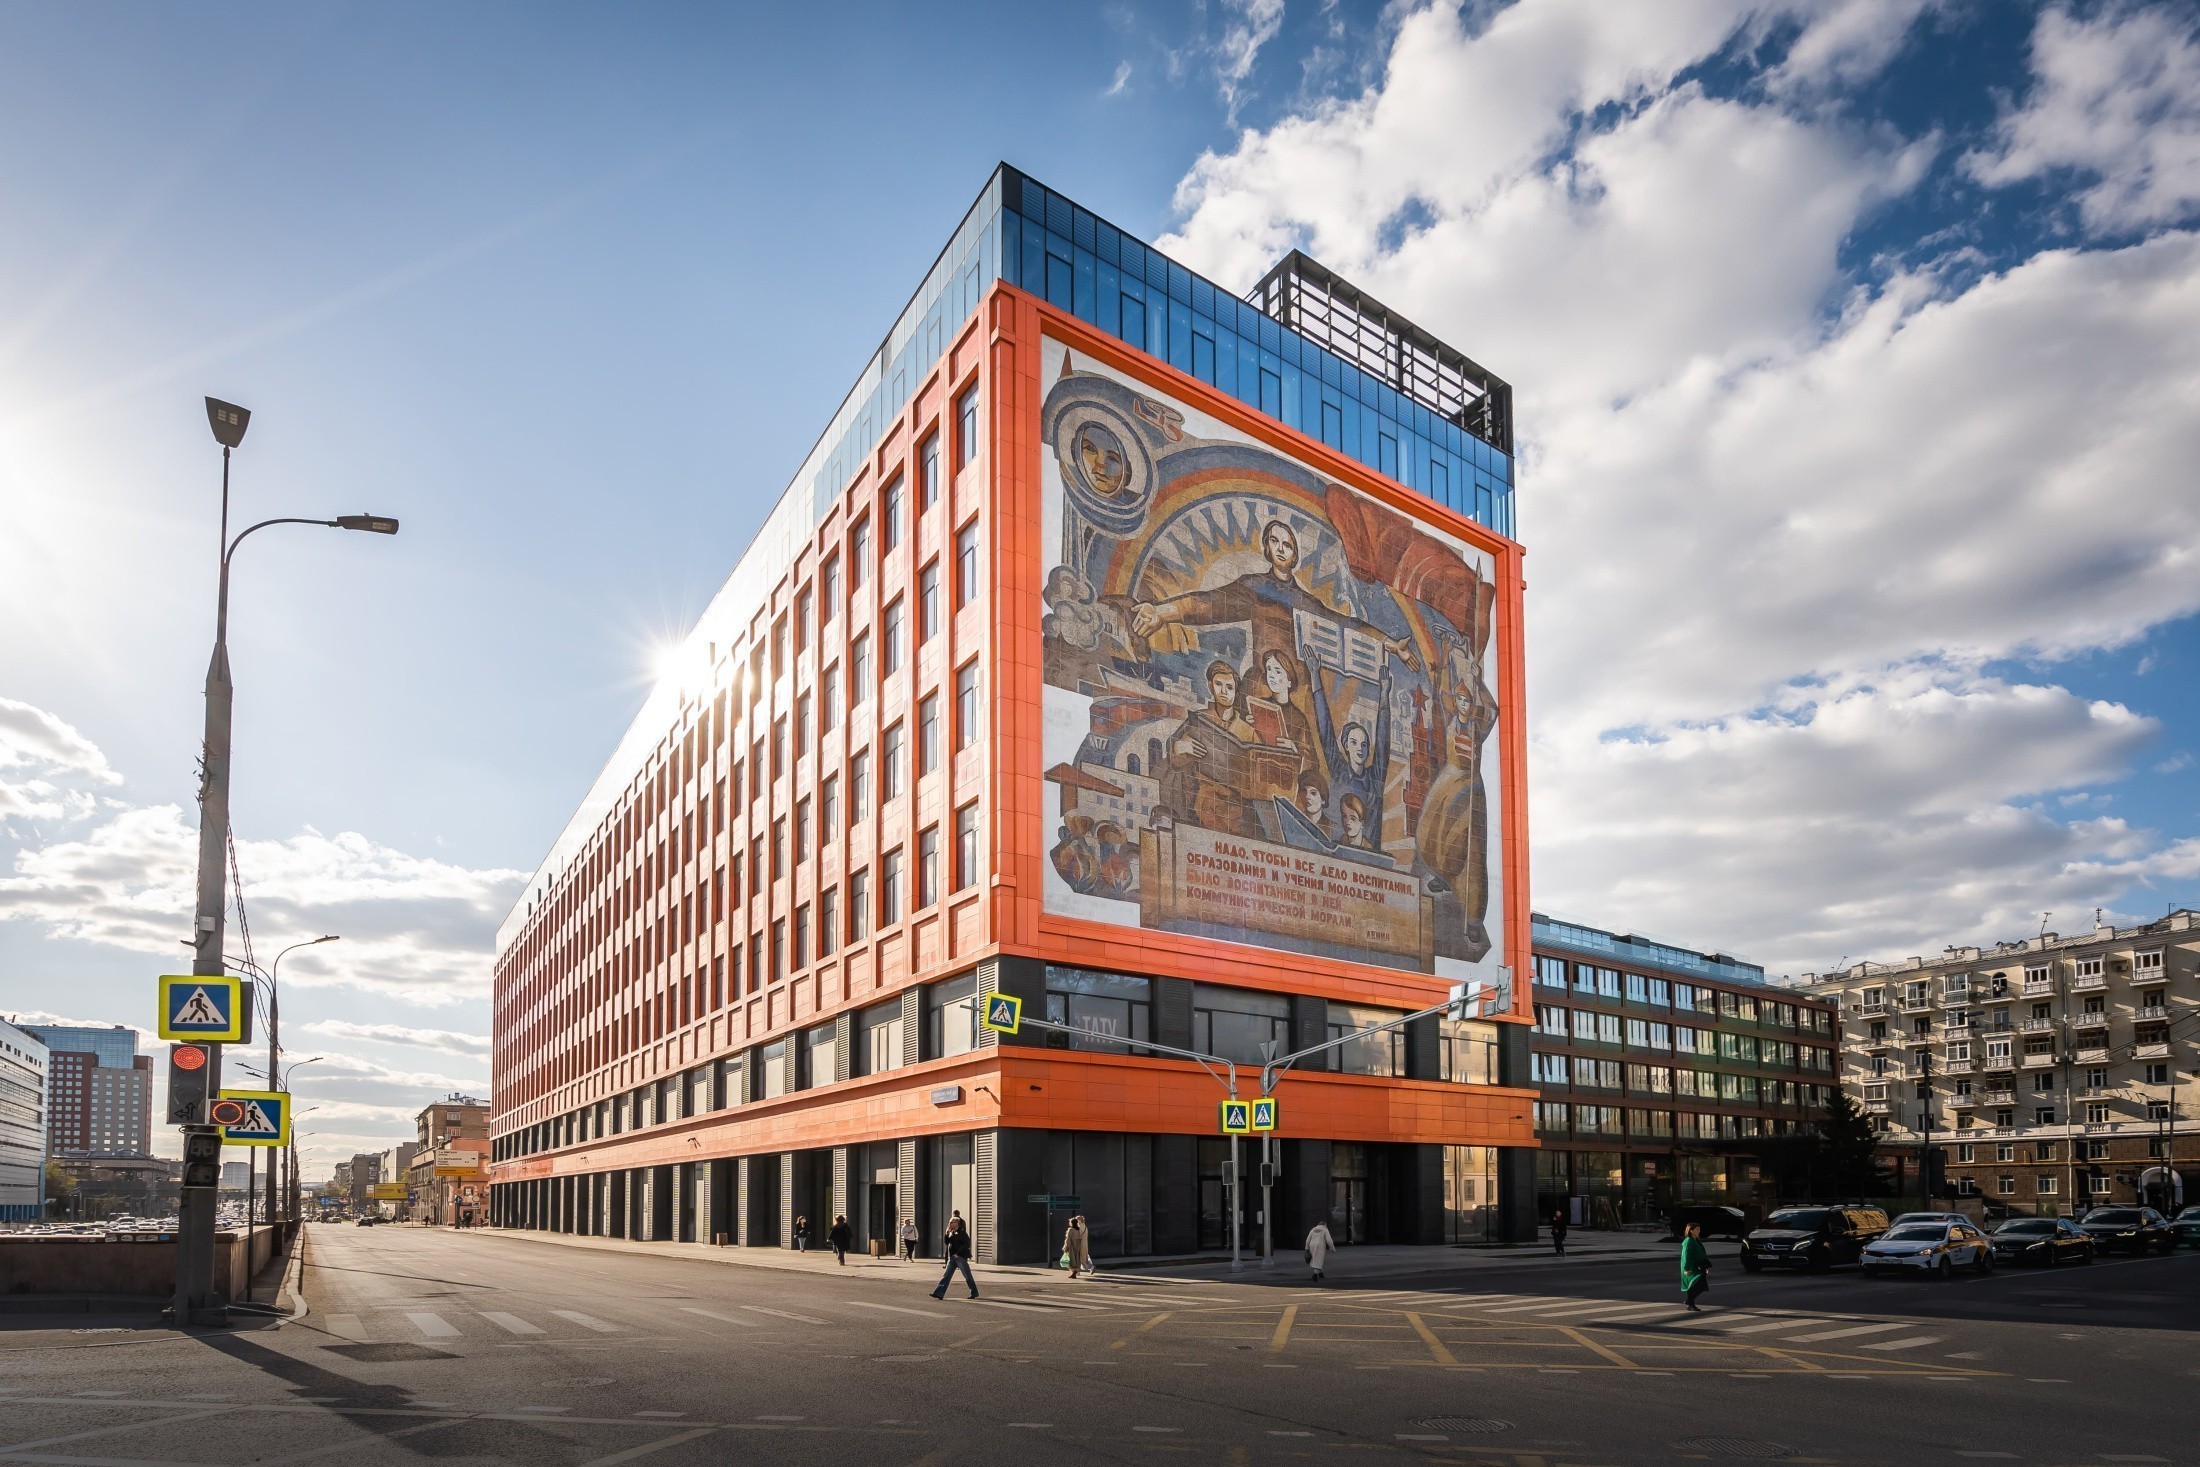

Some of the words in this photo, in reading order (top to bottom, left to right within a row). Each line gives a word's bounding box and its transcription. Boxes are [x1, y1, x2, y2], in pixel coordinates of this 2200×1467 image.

[1187, 852, 1266, 879] ОБРАЗОВАНИЯ
[1272, 869, 1279, 881] И
[1284, 872, 1324, 891] УЧЕНИЯ
[1328, 882, 1385, 904] МОЛОДЕЖИ
[1252, 849, 1290, 868] ЧТОБЫ
[1295, 858, 1315, 874] ВСЕ
[1320, 865, 1348, 880] ДЕЛО
[1186, 869, 1220, 886] БЫЛО
[1227, 876, 1306, 904] ВОСПИТАНИЕМ
[1322, 895, 1342, 911] НЕЙ
[1186, 885, 1306, 919] КОММУНИСТИЧЕСКОЙ
